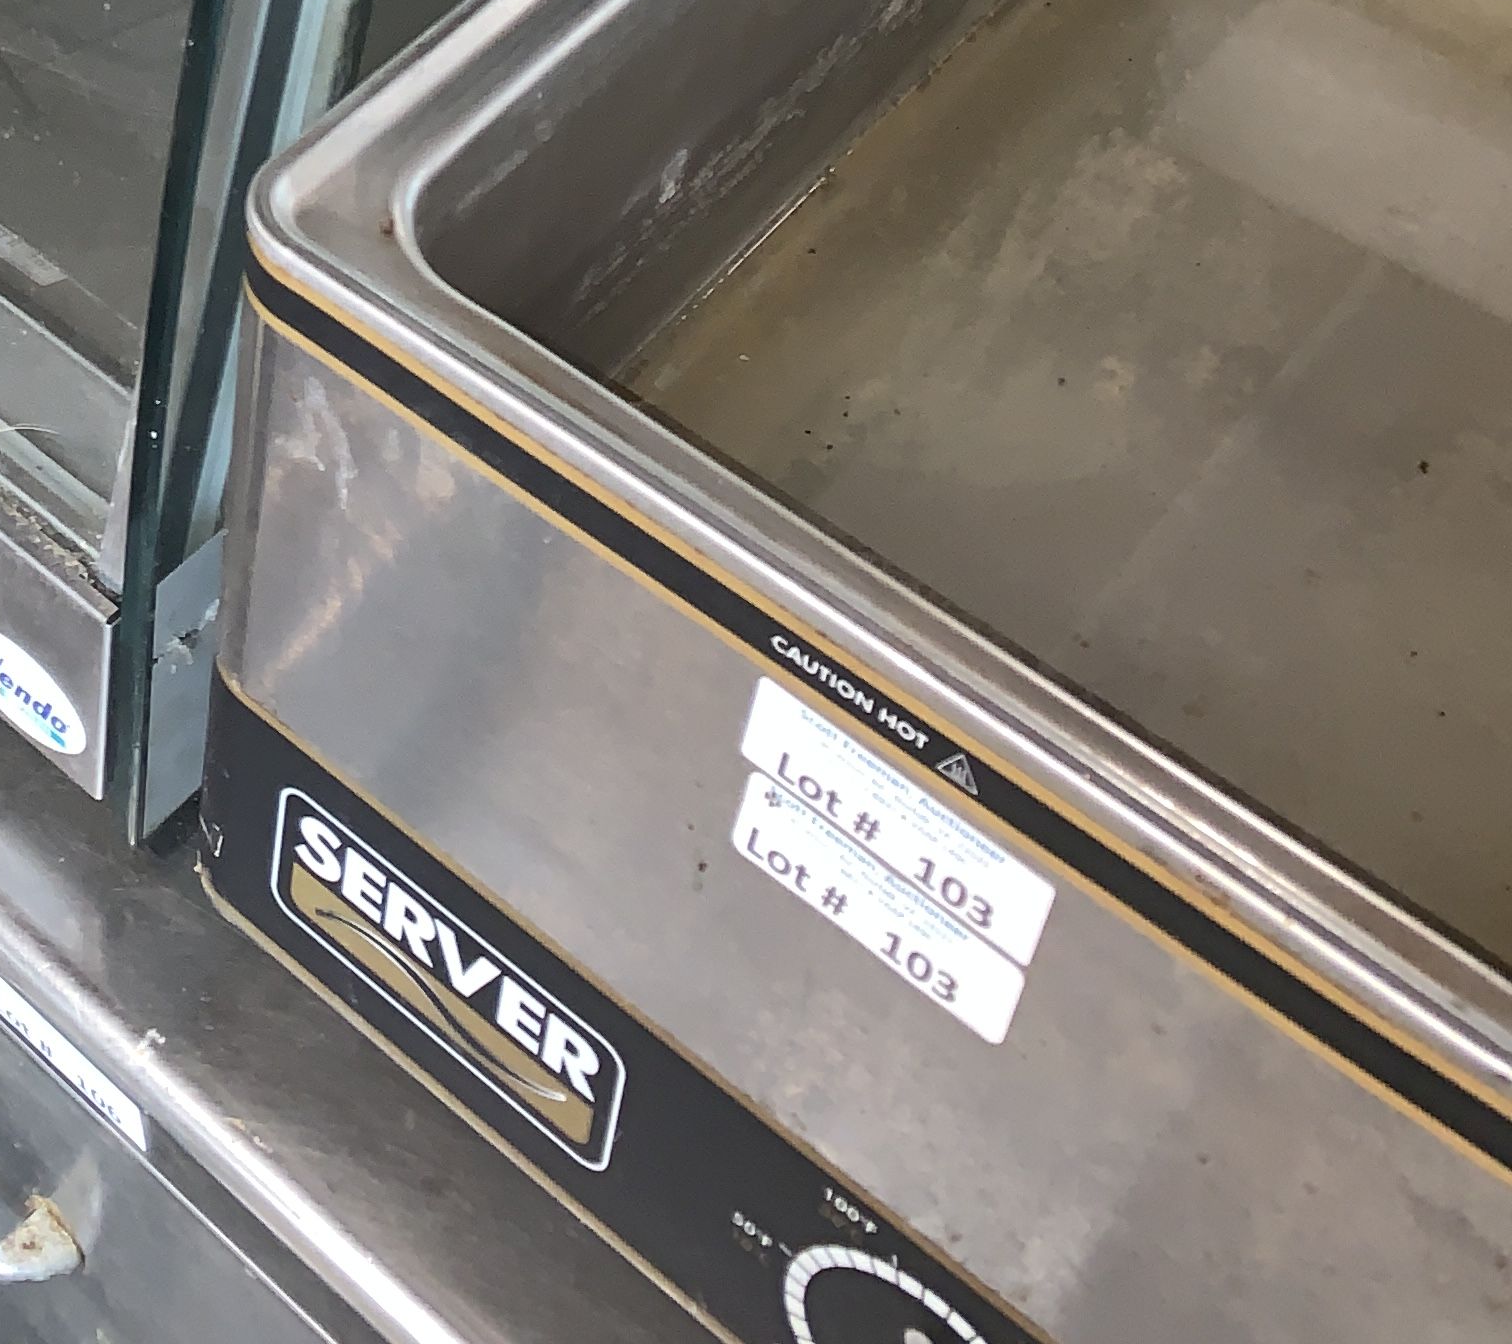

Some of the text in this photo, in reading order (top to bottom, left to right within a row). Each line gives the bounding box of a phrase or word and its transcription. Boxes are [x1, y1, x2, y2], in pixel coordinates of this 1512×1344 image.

[770, 634, 931, 750] CAUTION HOT
[746, 826, 810, 893] Lot
[820, 885, 849, 917] #
[879, 930, 960, 1004] 103
[778, 751, 842, 819] Lot
[853, 811, 881, 844] #
[913, 855, 995, 930] 103
[294, 815, 601, 1104] SERVER
